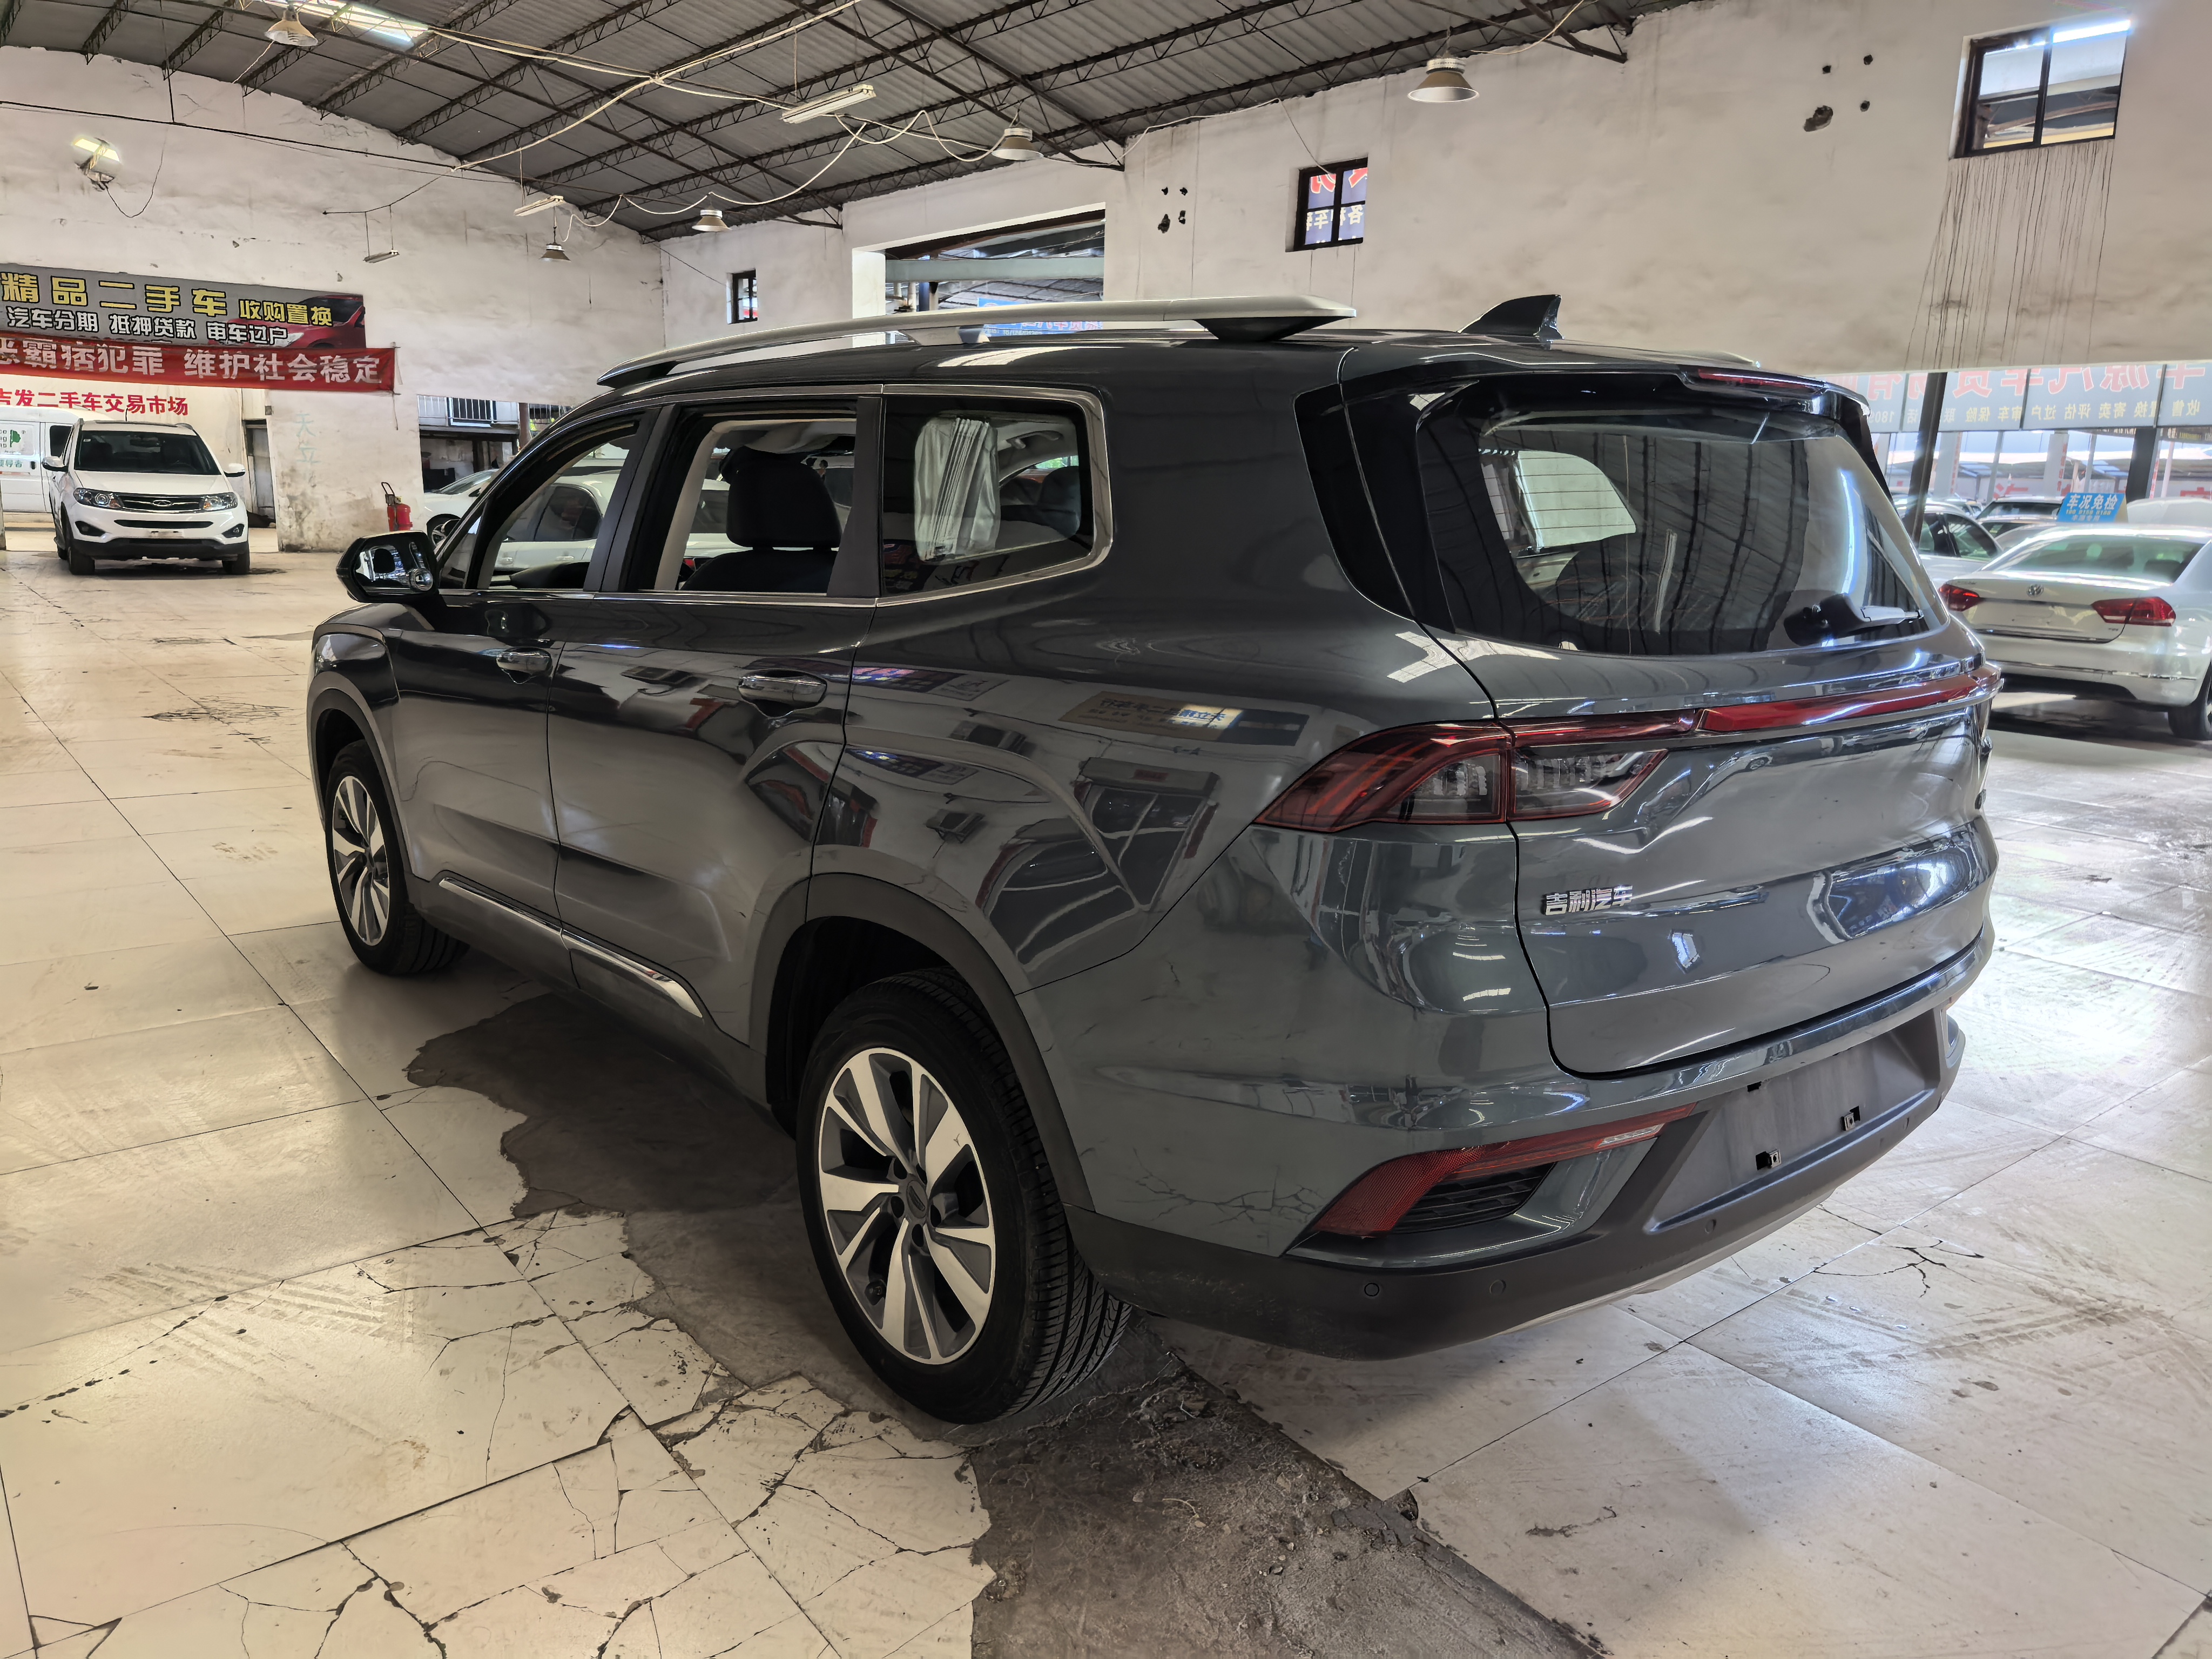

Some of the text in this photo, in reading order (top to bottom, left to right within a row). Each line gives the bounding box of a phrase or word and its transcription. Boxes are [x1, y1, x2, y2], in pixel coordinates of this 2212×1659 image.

[1, 272, 333, 327] 精品二手车 收购置换
[7, 306, 287, 345] 汽车分期 抵押贷款 审车过户
[184, 348, 382, 383] 维护社会稳定
[2067, 494, 2118, 510] 车况免检
[1545, 885, 1633, 916] 吉利汽车
